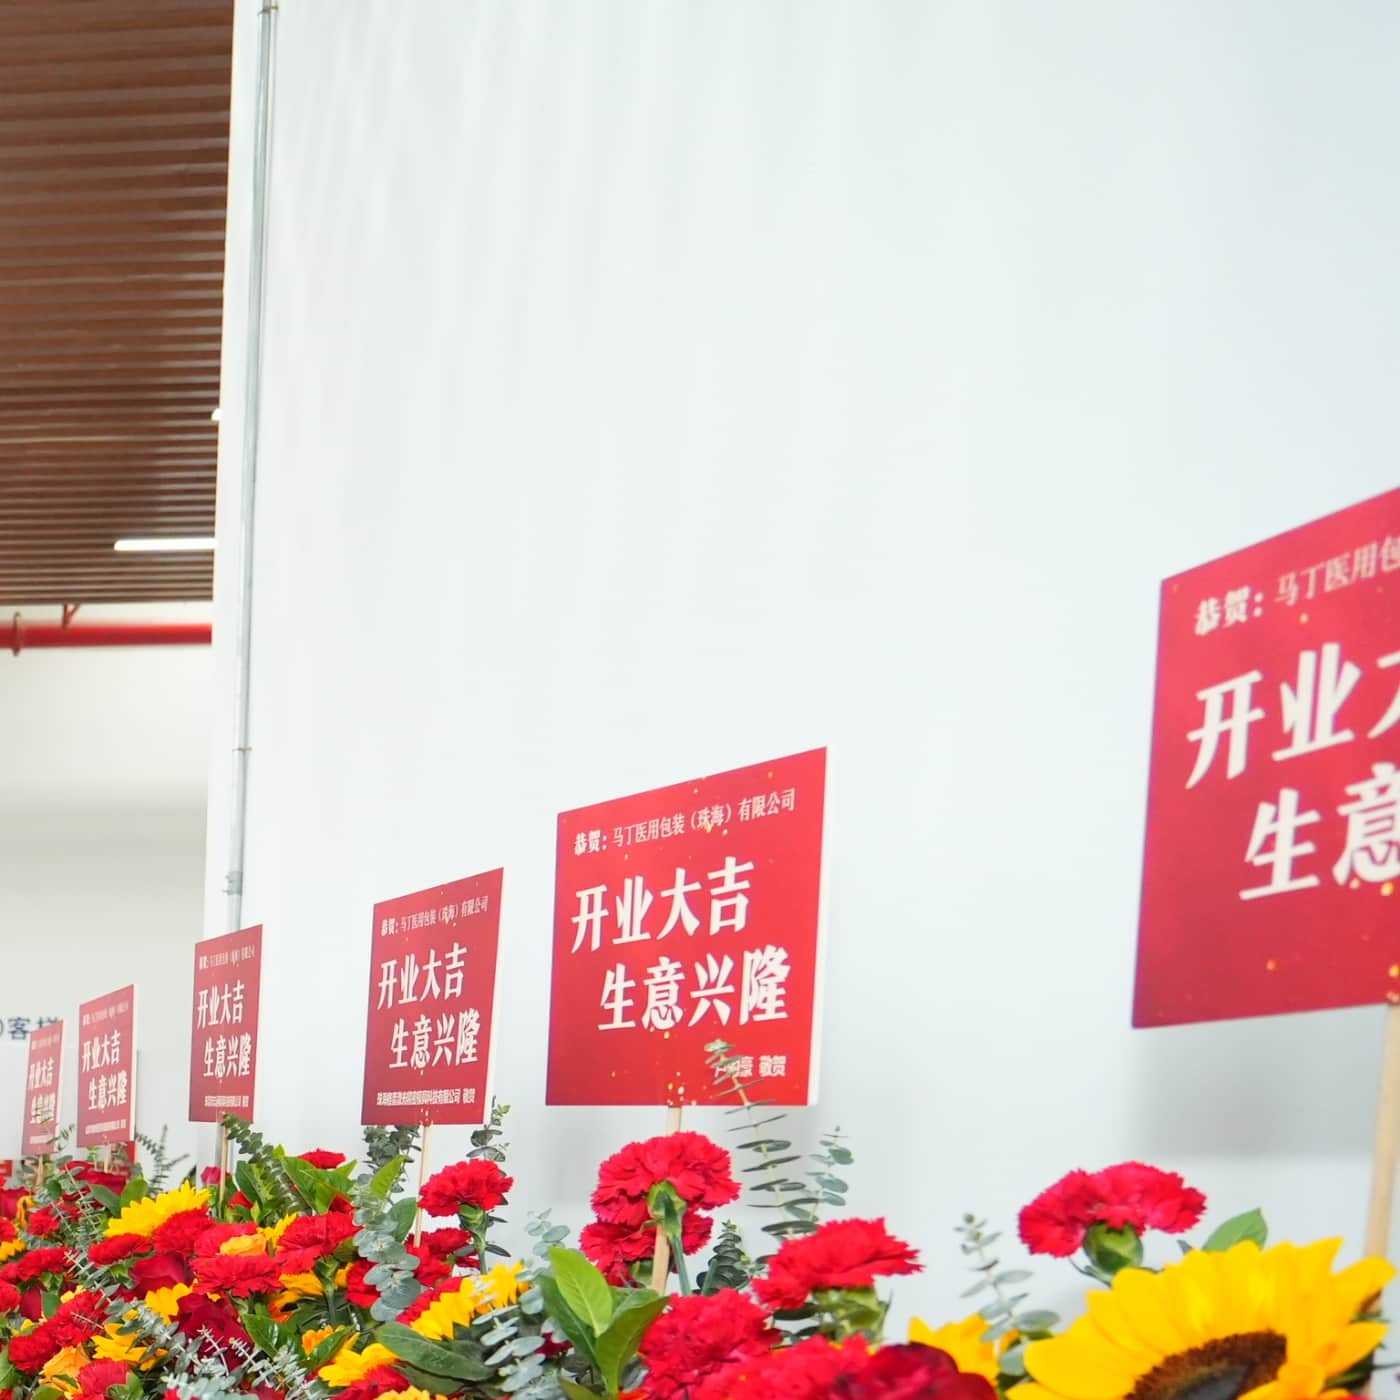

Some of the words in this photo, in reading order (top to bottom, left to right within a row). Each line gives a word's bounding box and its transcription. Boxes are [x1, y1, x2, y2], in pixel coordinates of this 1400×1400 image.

[571, 856, 754, 953] 开业大吉
[377, 943, 467, 1010] 开业大吉
[597, 944, 791, 1031] 生意兴隆
[197, 980, 245, 1030] 开业大吉
[82, 1030, 121, 1073] 开业大吉
[203, 1032, 252, 1078] 生意兴隆
[389, 1008, 480, 1069] 生意兴隆
[88, 1070, 128, 1110] 生意兴隆
[759, 1055, 787, 1078] 敬贺
